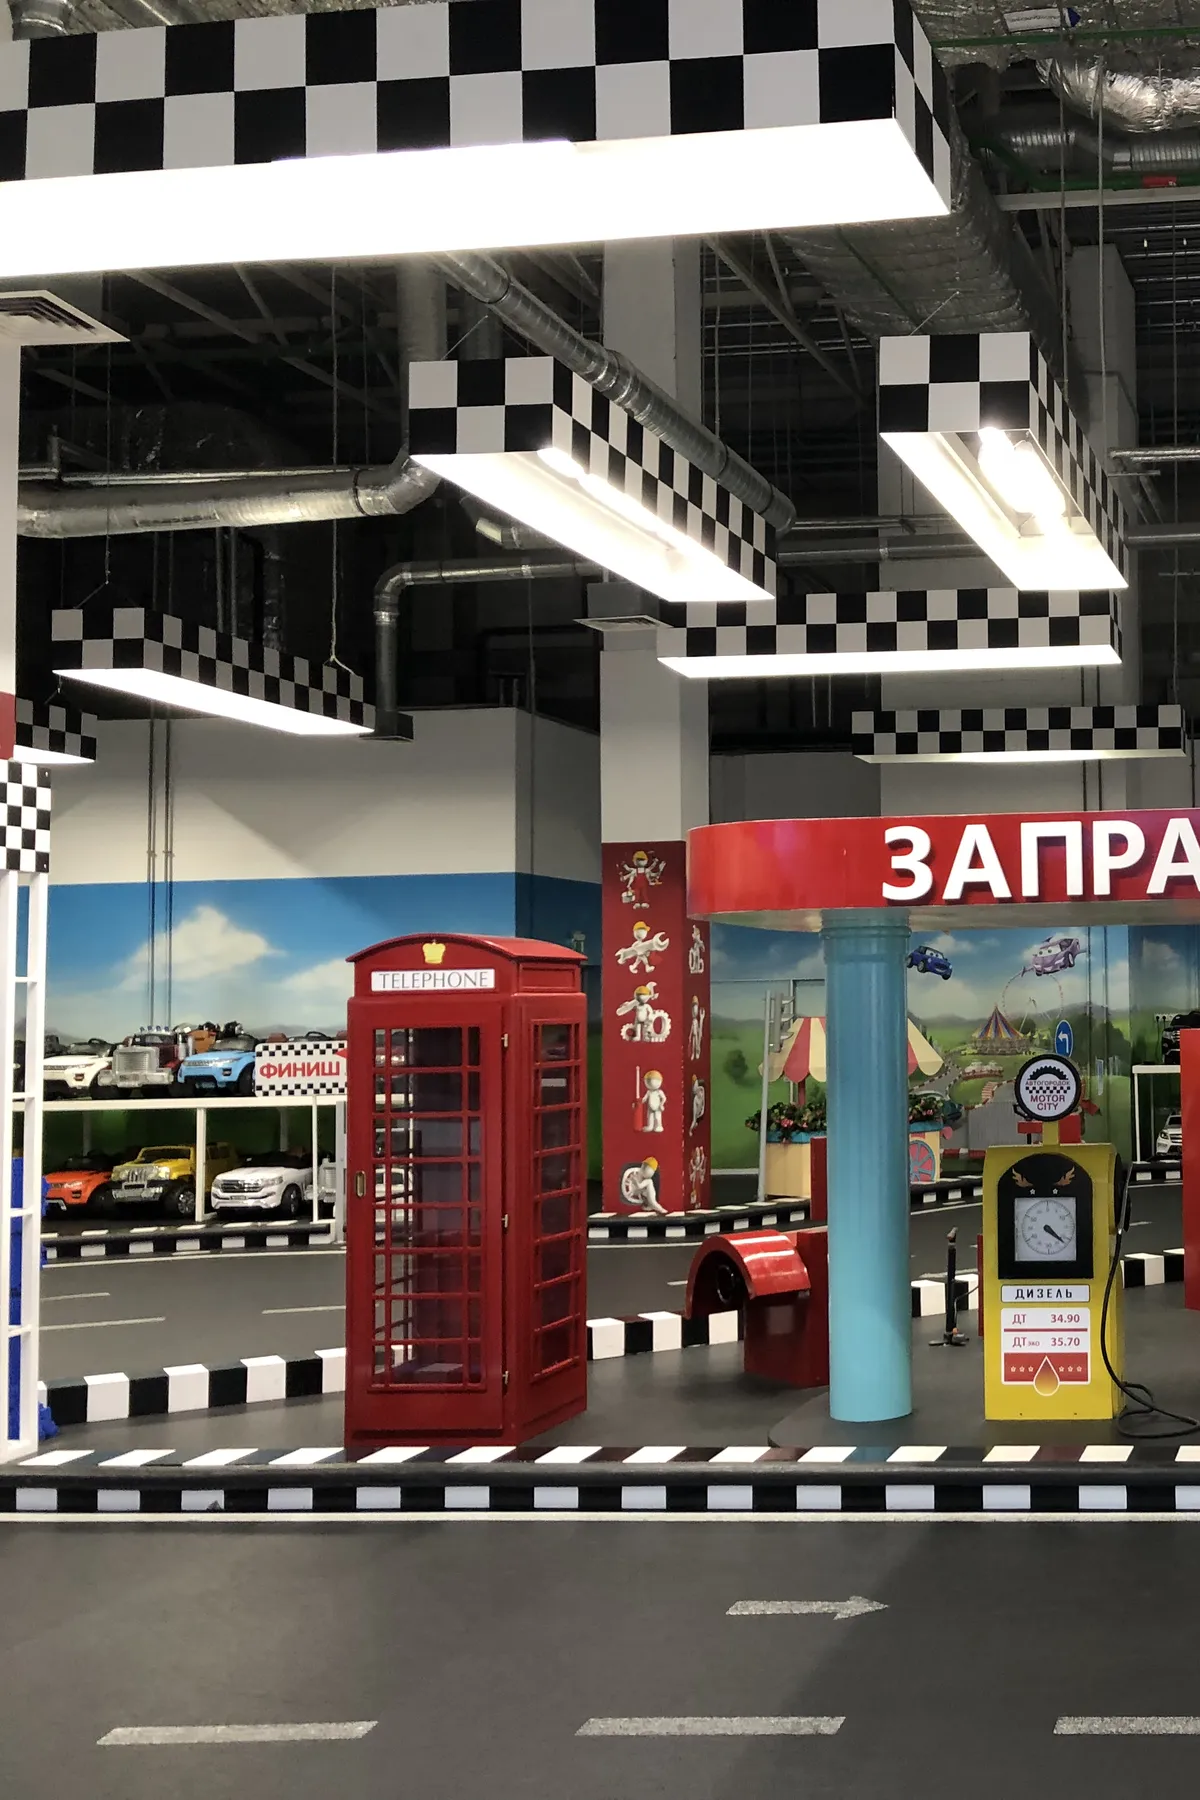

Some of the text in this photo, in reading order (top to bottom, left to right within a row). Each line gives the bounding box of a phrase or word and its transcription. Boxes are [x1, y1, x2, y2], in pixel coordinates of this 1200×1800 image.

[379, 971, 488, 989] TELEPHONE
[259, 1061, 340, 1080] ФИНИШ
[1030, 1094, 1066, 1102] MOTOR
[1037, 1102, 1059, 1110] CITY
[1015, 1288, 1073, 1300] ДИЗЕЛЬ
[1012, 1313, 1080, 1325] ДТ 34.90
[1050, 1337, 1080, 1347] 35.70
